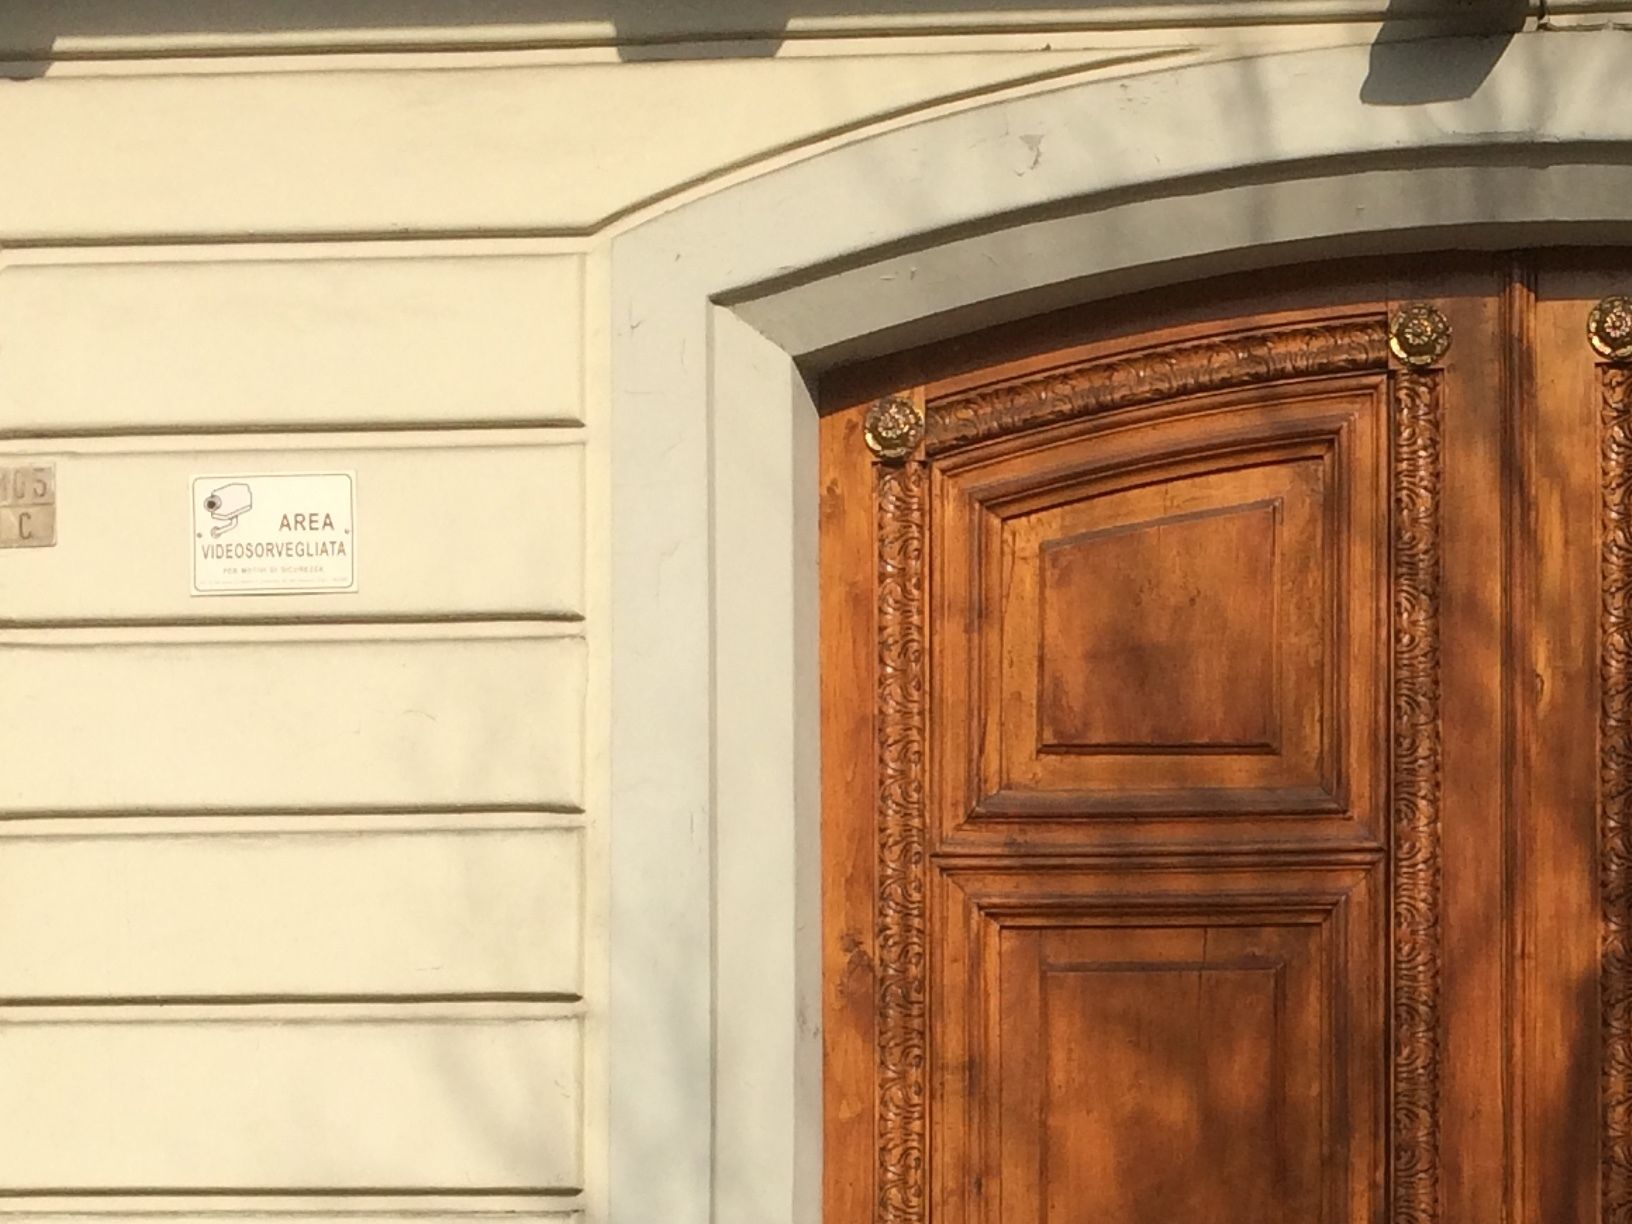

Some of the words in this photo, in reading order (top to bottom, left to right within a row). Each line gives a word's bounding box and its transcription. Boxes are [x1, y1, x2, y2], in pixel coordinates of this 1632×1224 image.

[19, 512, 33, 540] C
[279, 513, 335, 532] AREA
[201, 541, 346, 560] VIDEOSORVEGLIATA
